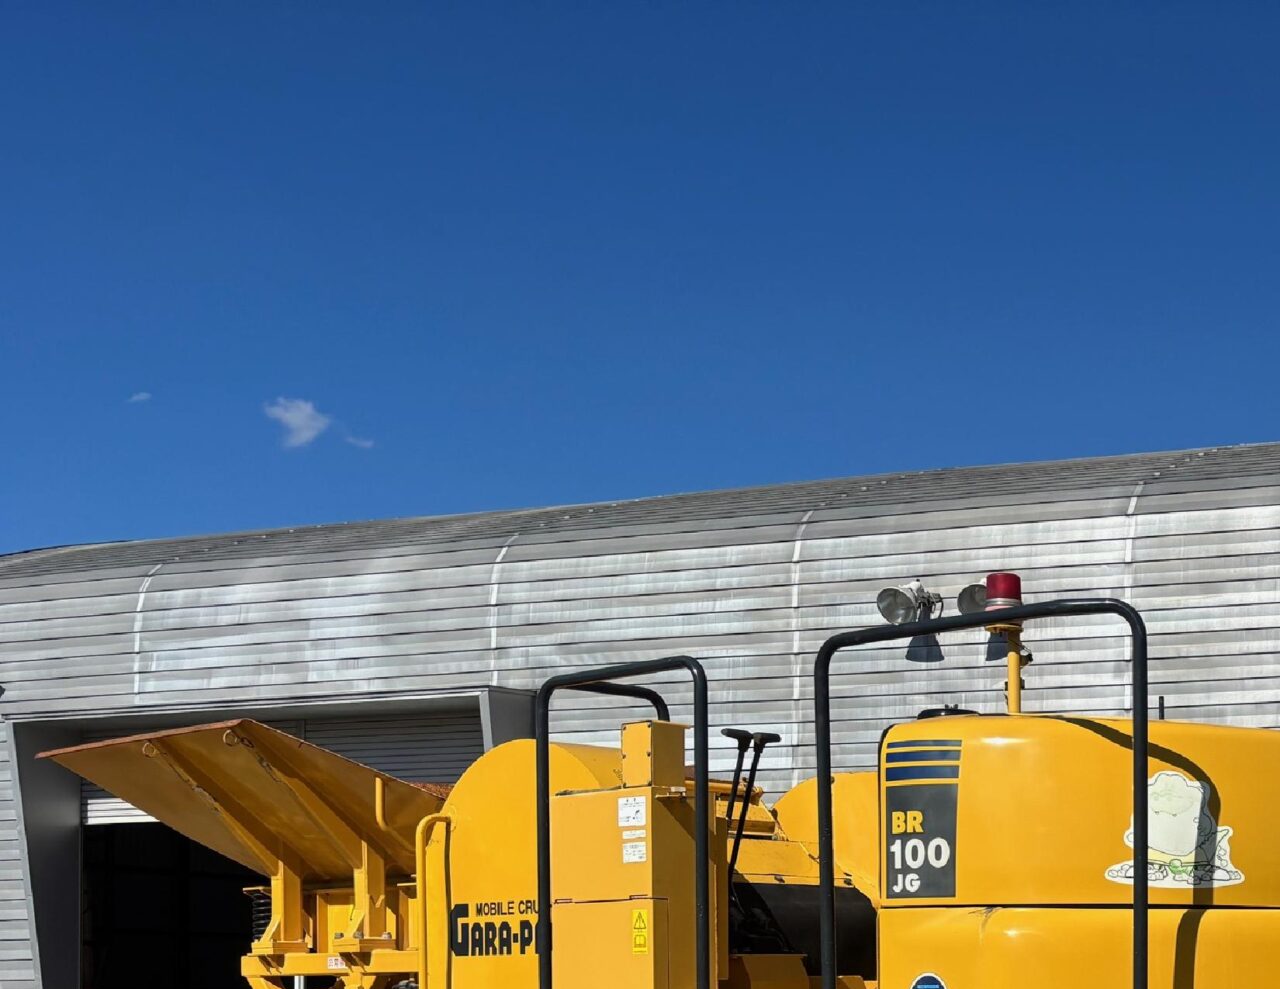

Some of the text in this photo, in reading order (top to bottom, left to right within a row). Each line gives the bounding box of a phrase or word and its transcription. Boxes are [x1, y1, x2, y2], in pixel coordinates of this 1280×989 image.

[892, 811, 924, 834] BR
[890, 837, 950, 869] 100
[893, 873, 920, 893] JG
[476, 902, 515, 916] MOBILE
